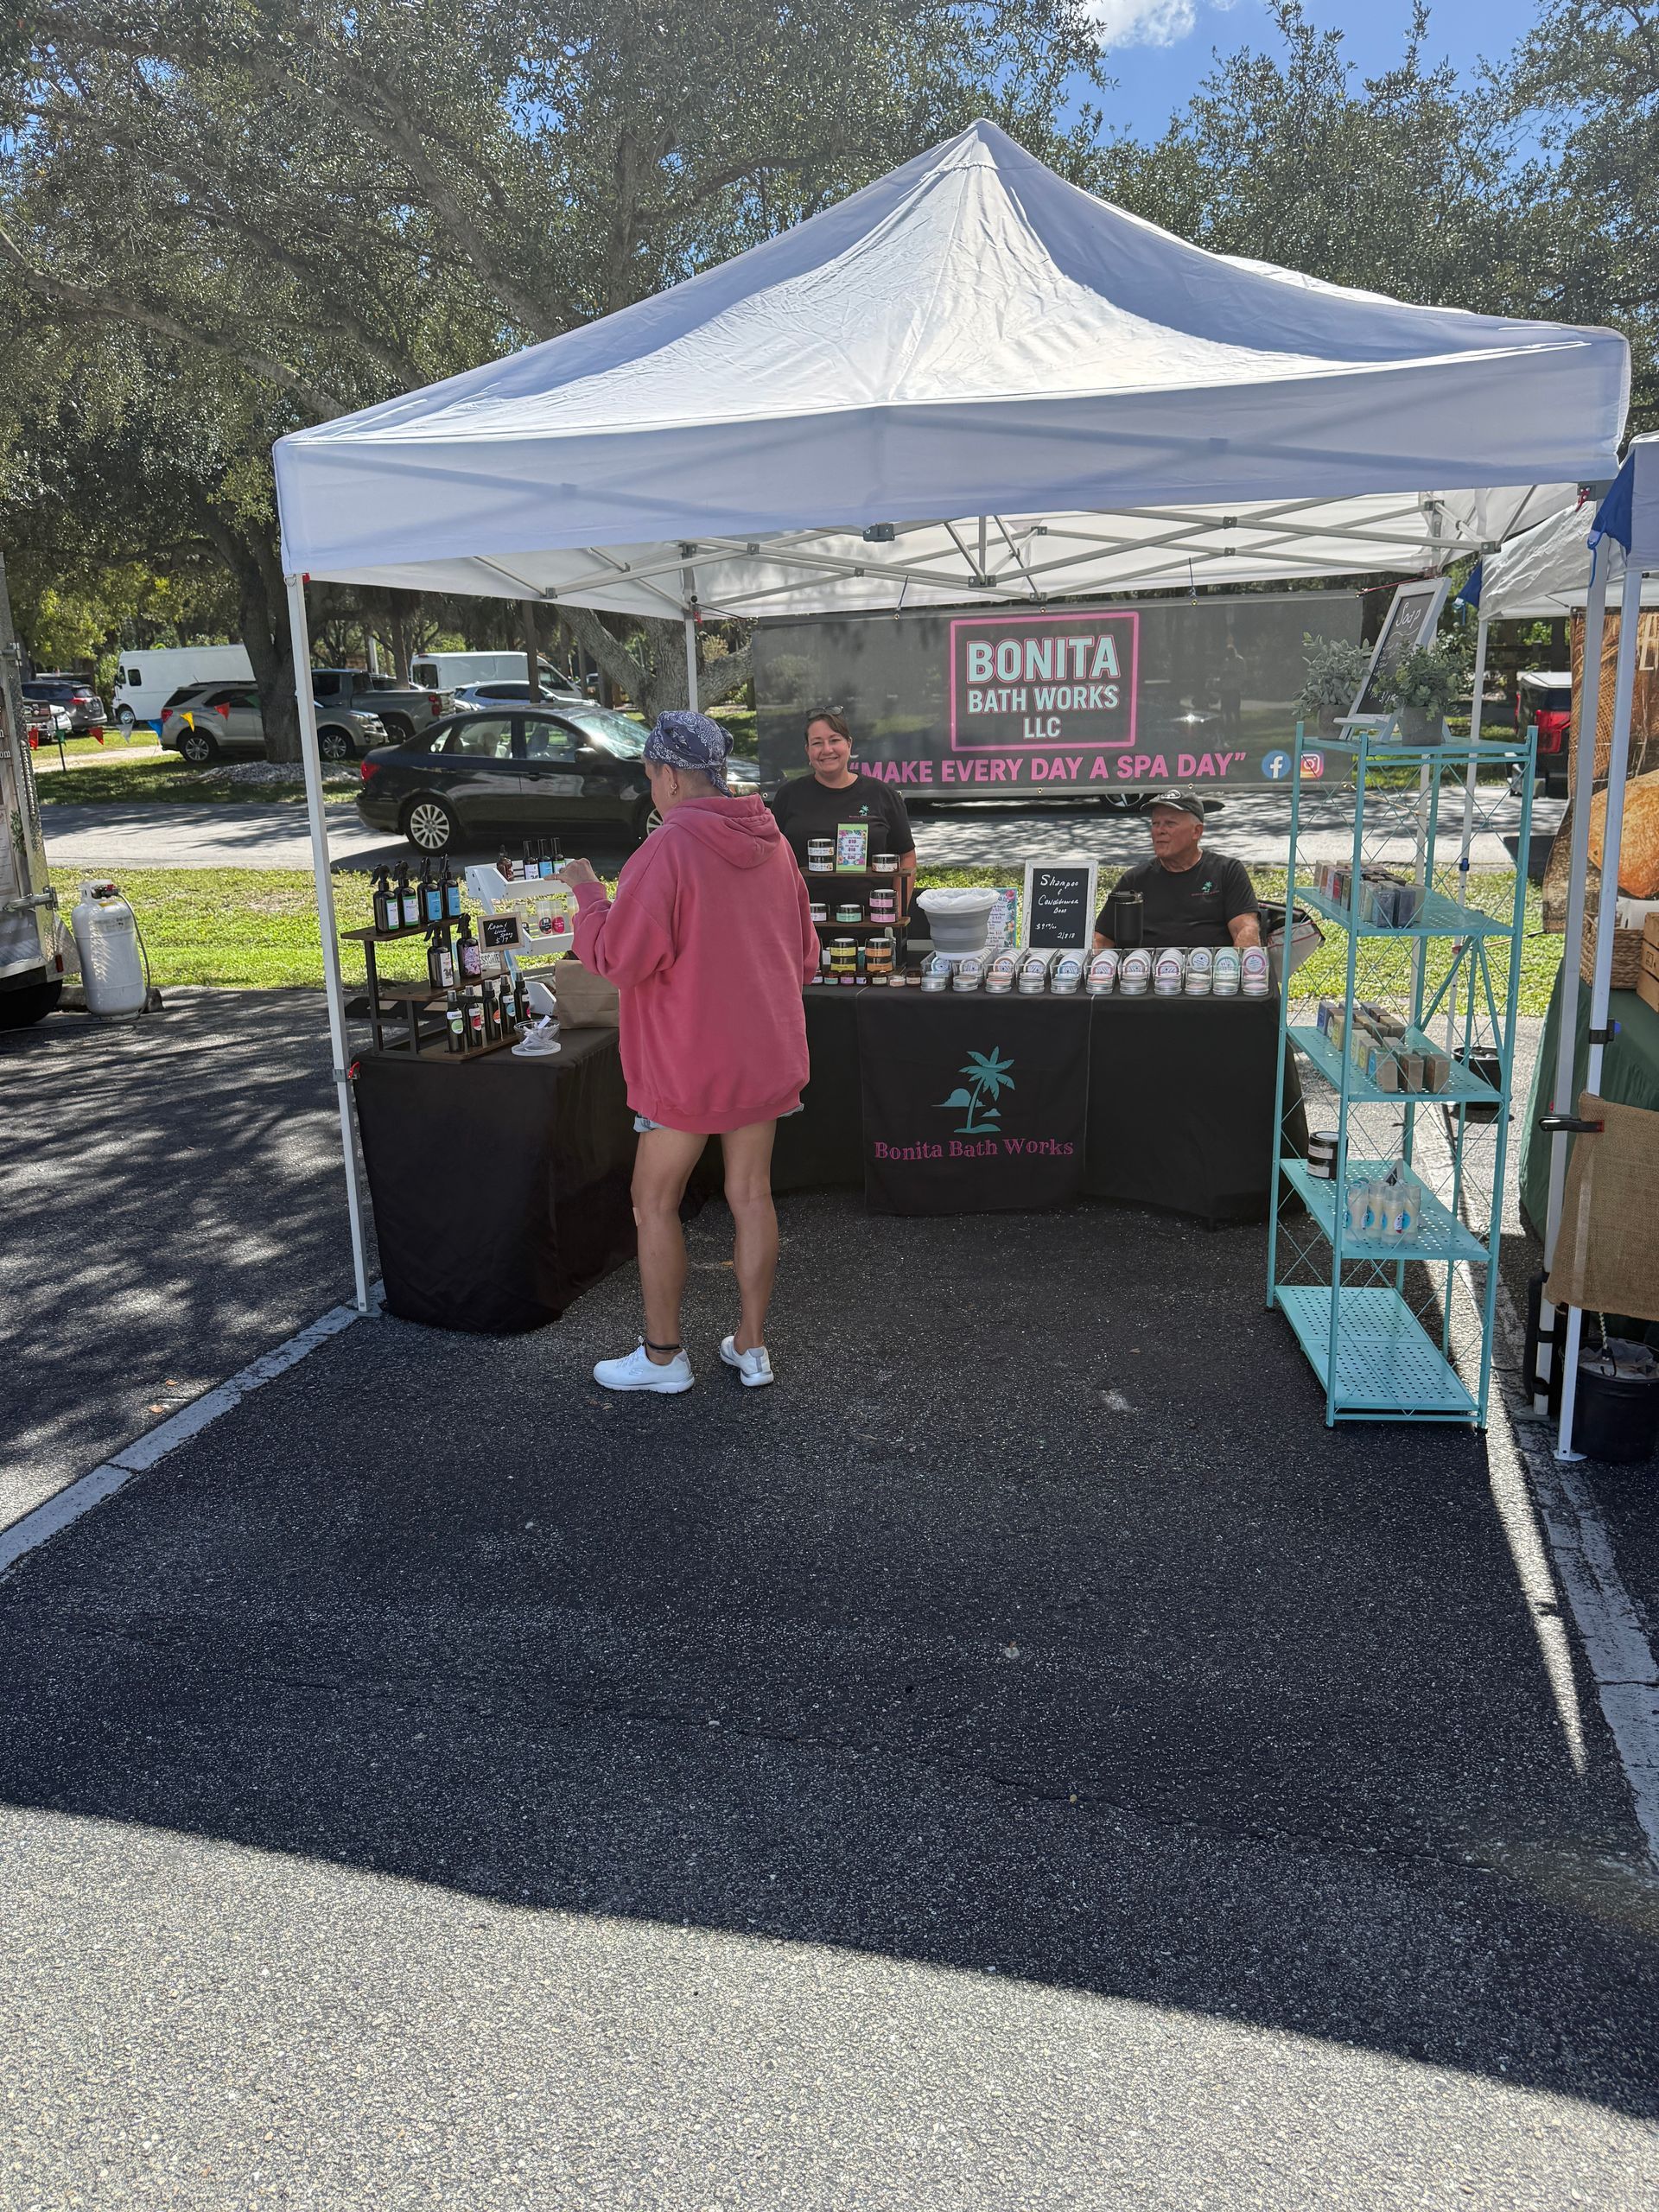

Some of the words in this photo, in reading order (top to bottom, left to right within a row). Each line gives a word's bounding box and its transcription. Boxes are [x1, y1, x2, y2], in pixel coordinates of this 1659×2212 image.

[1395, 601, 1421, 629] Soap
[966, 635, 1121, 683] BONITA
[968, 687, 1027, 714] BATH
[1033, 683, 1119, 712] WORKS
[1024, 717, 1061, 739] LLC
[941, 758, 1023, 782] EVERY
[1030, 756, 1083, 780] DAY
[1090, 756, 1109, 779] A
[1116, 754, 1169, 779] SPA
[1039, 874, 1079, 889] Shampoo
[874, 1141, 943, 1160] Bonita
[949, 1139, 998, 1158] Bath
[1002, 1138, 1074, 1156] Works
